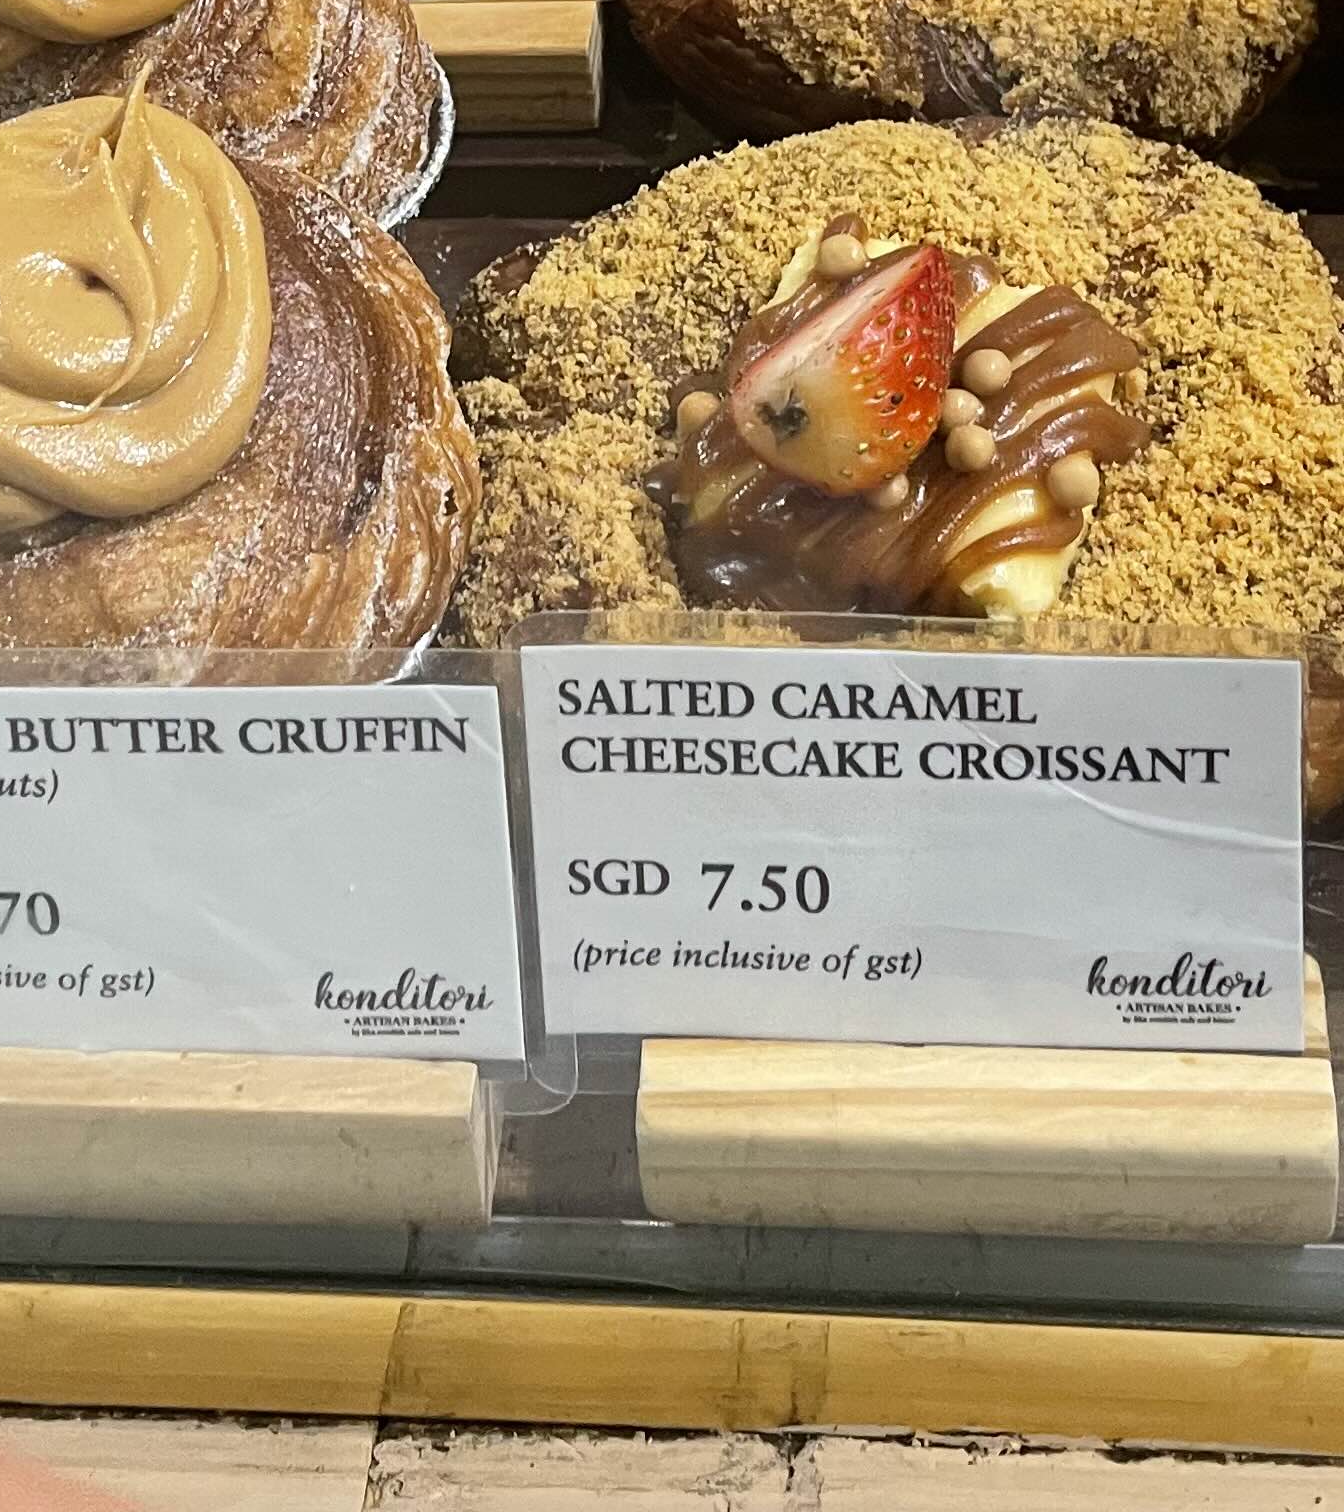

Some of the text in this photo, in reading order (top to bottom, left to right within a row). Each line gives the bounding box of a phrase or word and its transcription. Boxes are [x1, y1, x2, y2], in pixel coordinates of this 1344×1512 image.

[557, 678, 1039, 726] SALTED CARAMEL
[7, 715, 225, 756] BUTTER
[238, 715, 469, 755] CRUFFIN
[560, 735, 1231, 785] CHEESECAKE CROISSANT
[567, 859, 831, 914] SGD 7.50
[57, 964, 94, 998] of
[99, 966, 156, 998] gst)
[572, 939, 923, 981] (price inclusive of gst)
[1087, 952, 1272, 998] konditori
[314, 967, 494, 1011] konditori
